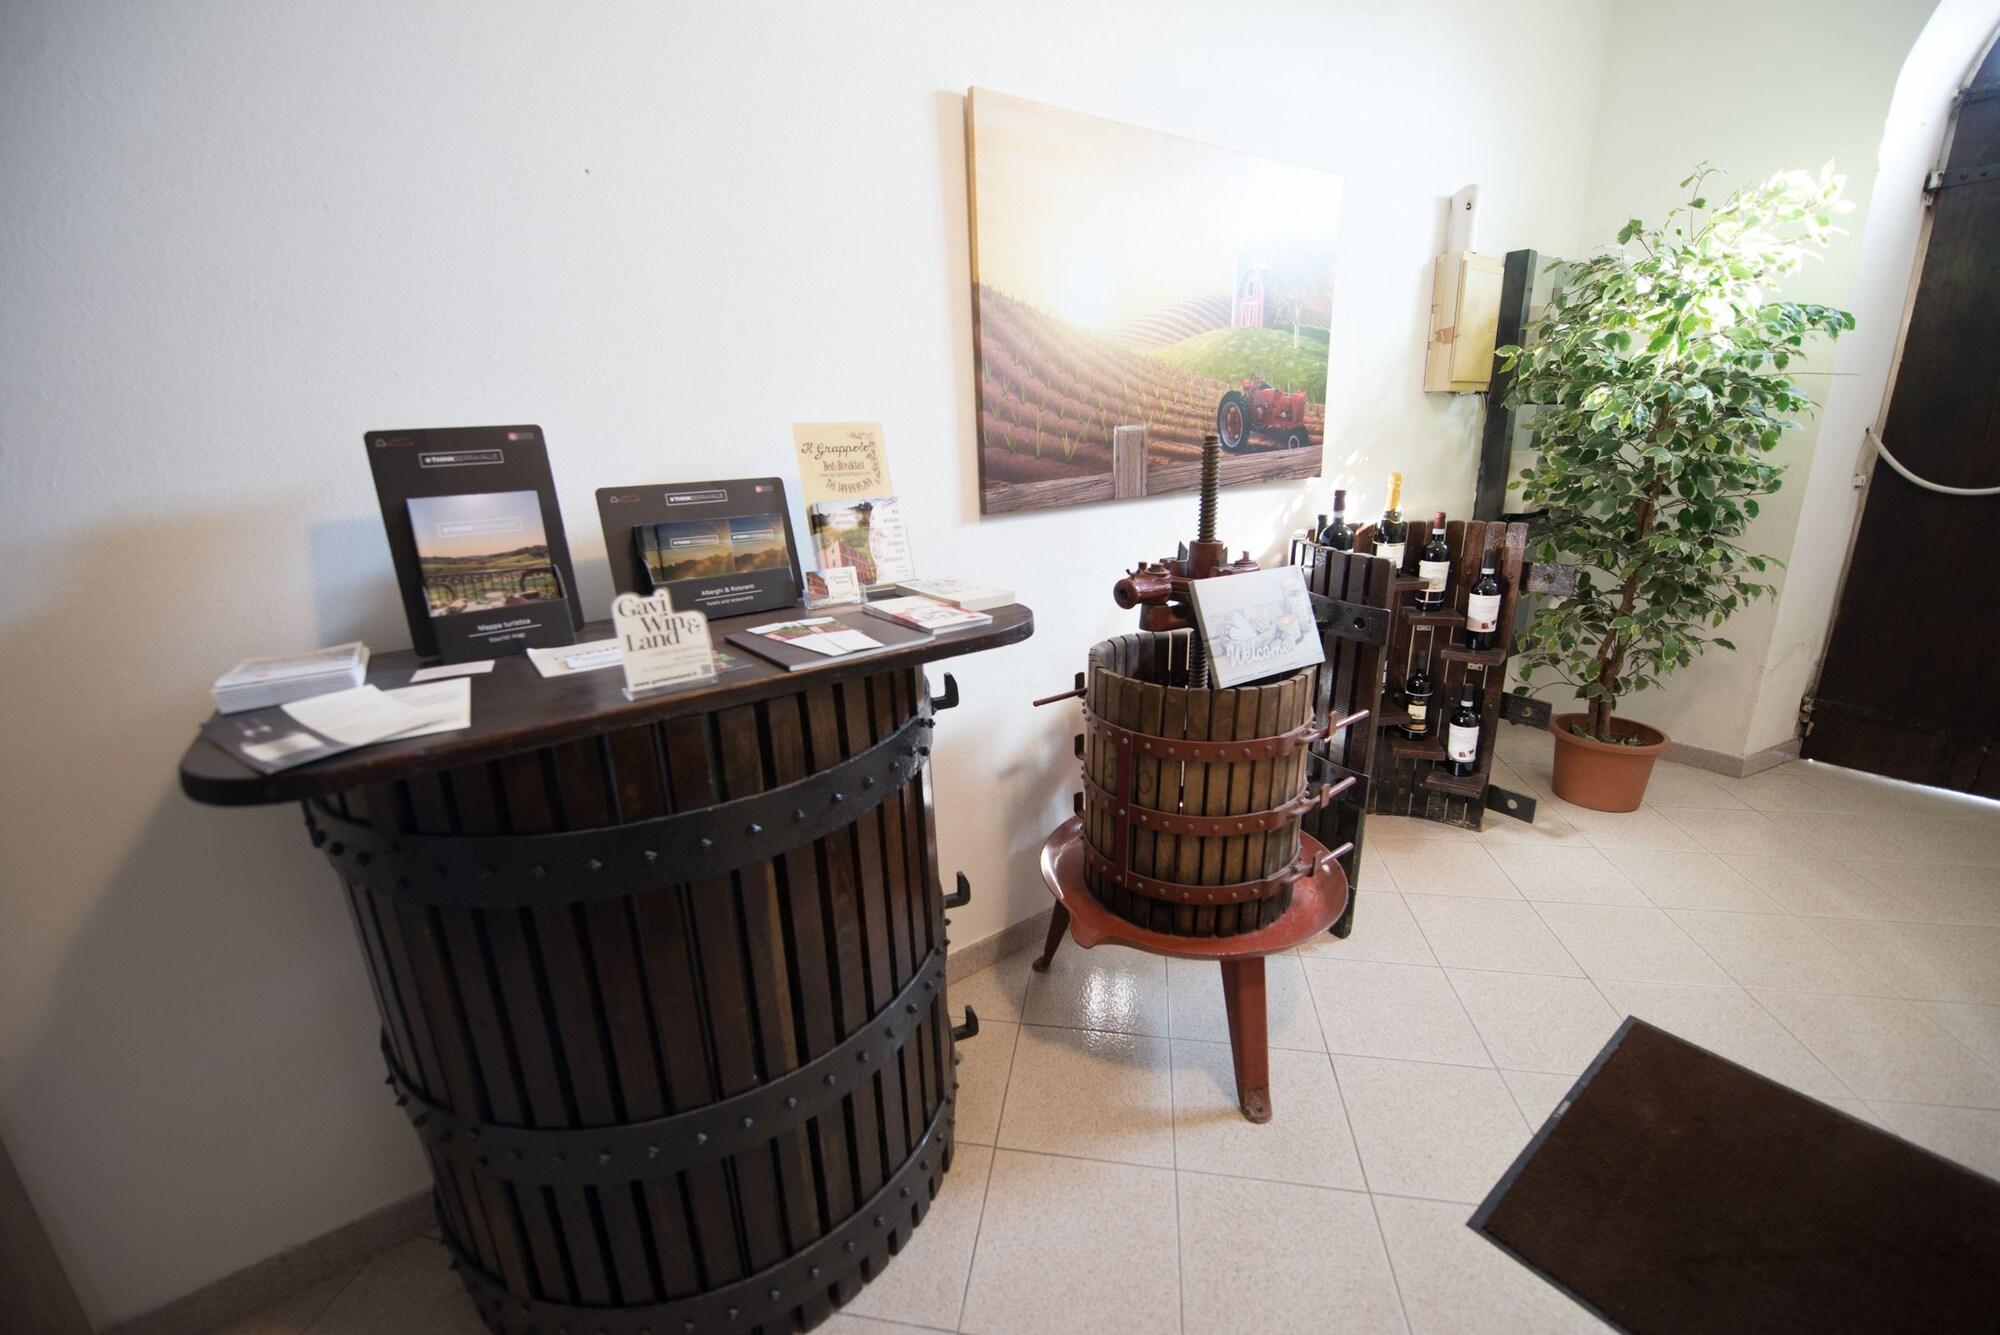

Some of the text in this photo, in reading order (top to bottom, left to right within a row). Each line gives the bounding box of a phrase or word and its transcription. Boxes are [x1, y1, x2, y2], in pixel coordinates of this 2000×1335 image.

[618, 593, 667, 617] Gavi
[625, 620, 681, 652] Land
[1227, 641, 1290, 667] Welcome
